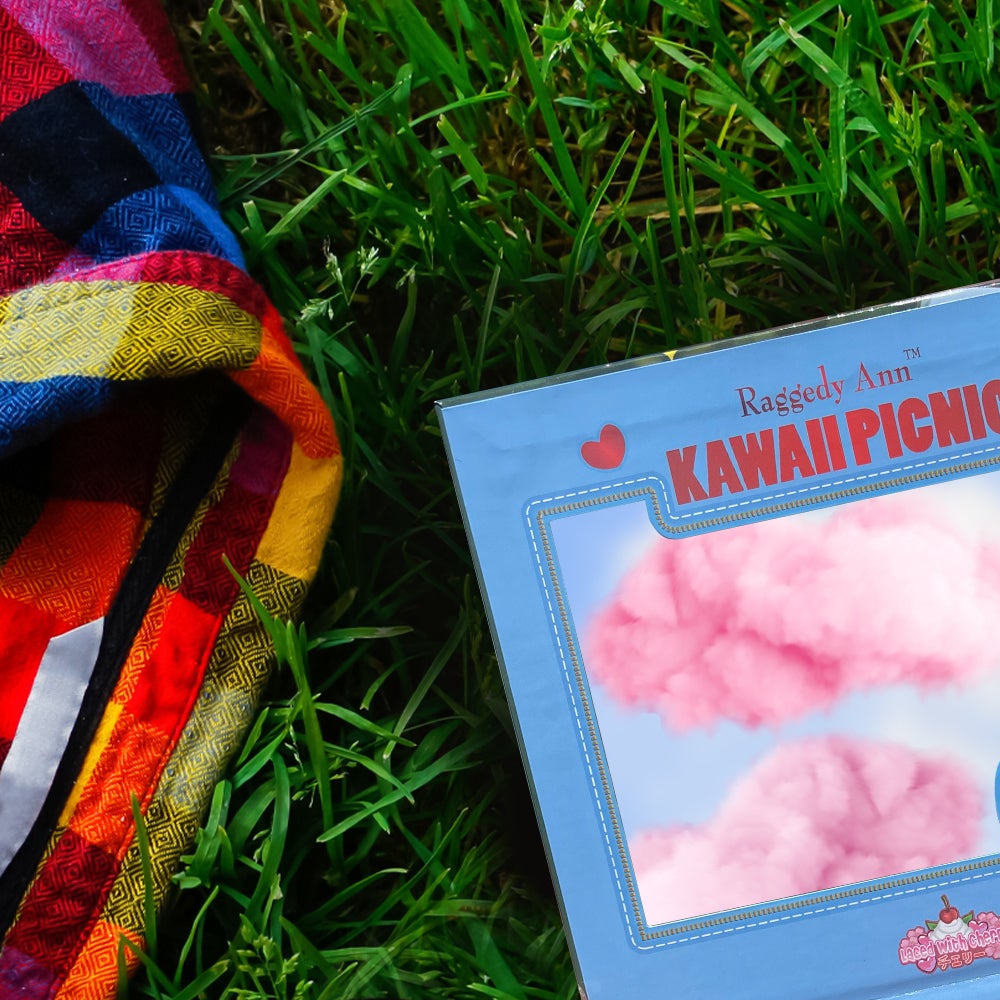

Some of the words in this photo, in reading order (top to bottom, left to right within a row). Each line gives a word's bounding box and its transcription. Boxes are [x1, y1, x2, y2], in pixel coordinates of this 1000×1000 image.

[735, 364, 845, 418] Raggedy
[665, 414, 848, 506] KAWAII
[899, 938, 936, 962] Laced
